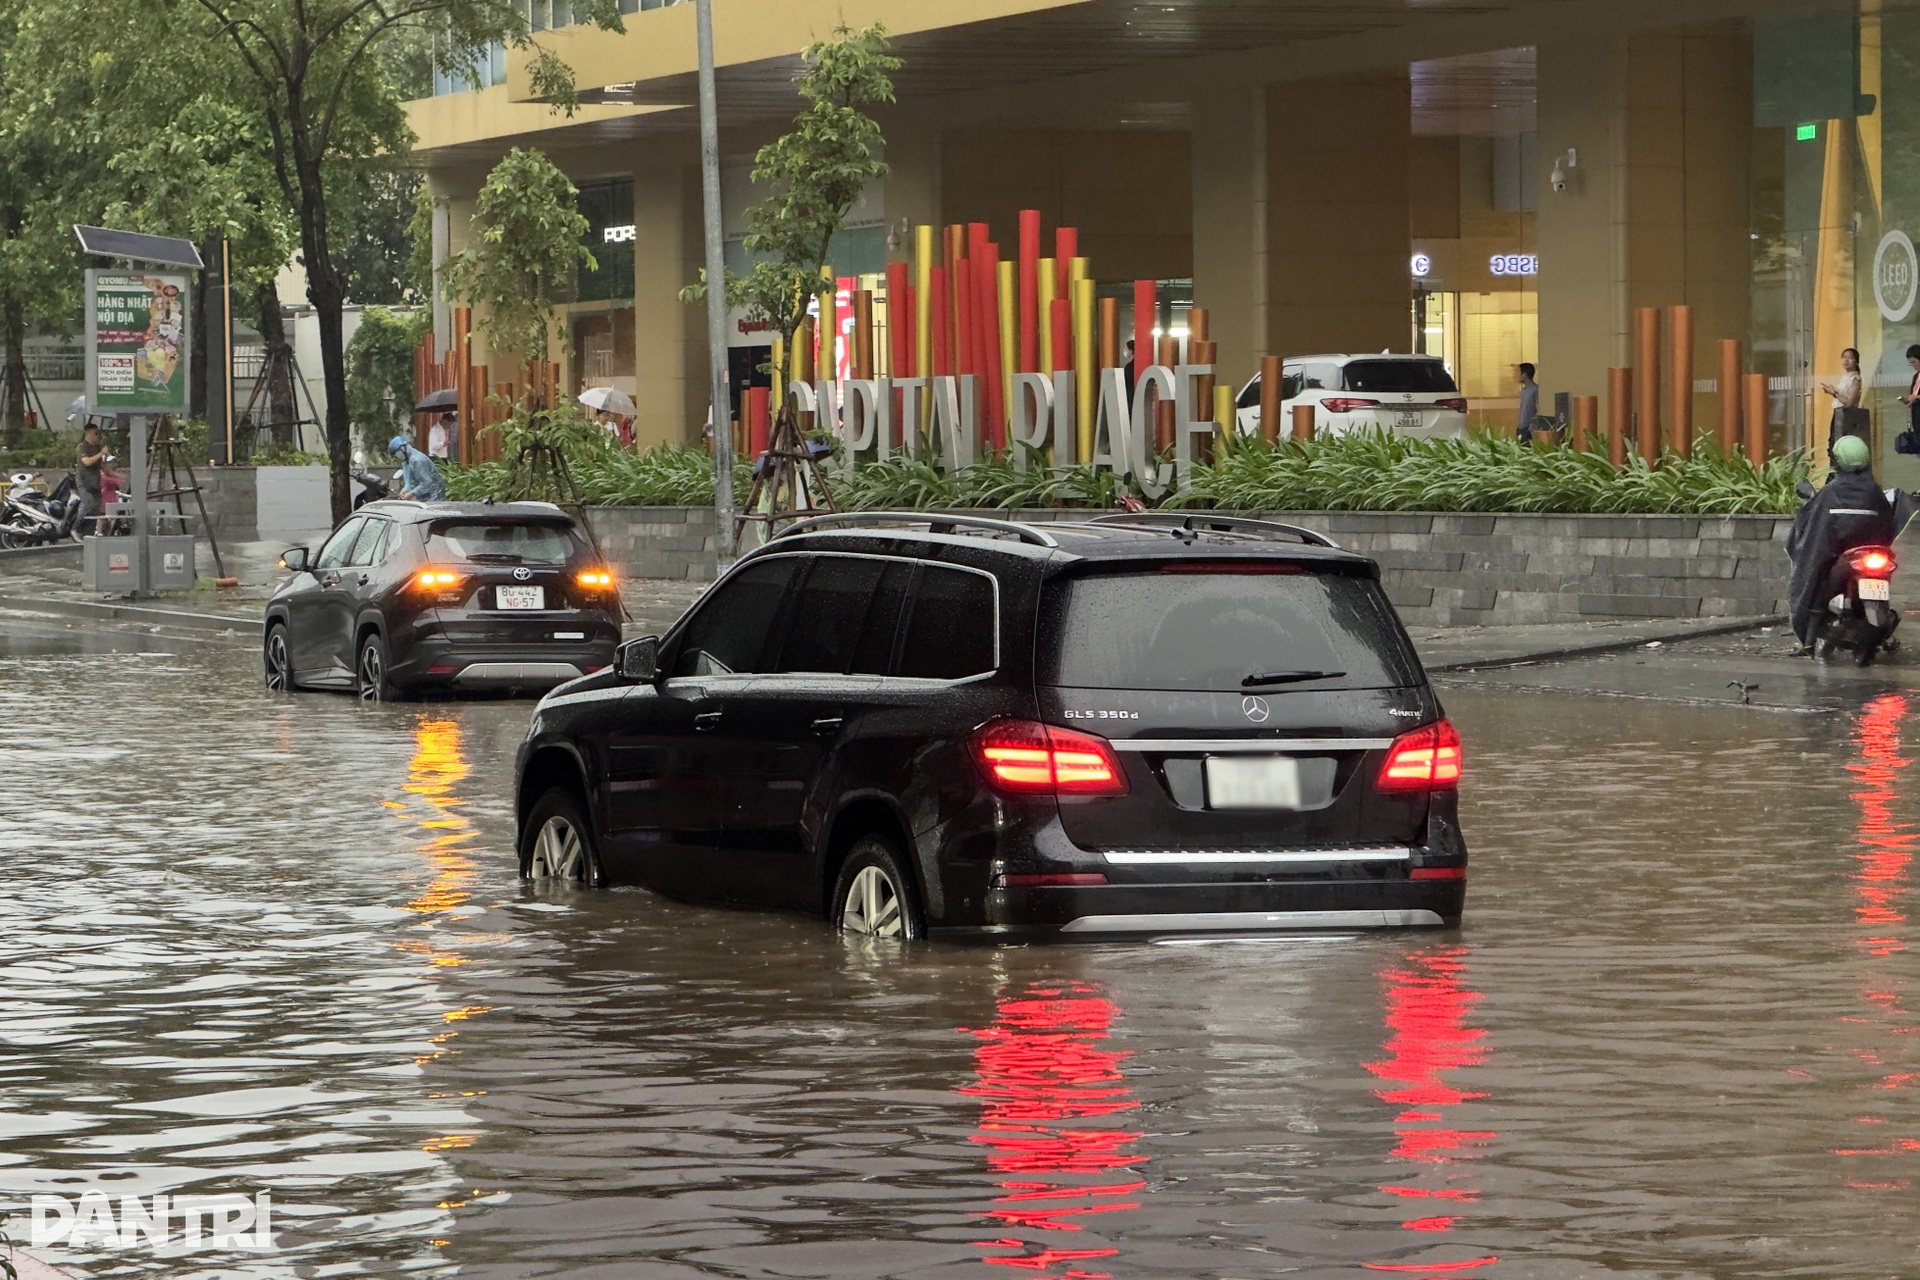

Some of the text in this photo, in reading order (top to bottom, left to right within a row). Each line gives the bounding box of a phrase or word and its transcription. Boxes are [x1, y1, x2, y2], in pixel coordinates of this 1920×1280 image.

[98, 276, 129, 285] GYOMU
[1882, 263, 1908, 286] LEED
[97, 294, 152, 311] HÀNG NHẬT
[97, 310, 135, 325] NỘI ĐỊA
[100, 359, 122, 367] 100%
[1063, 710, 1094, 719] GLS
